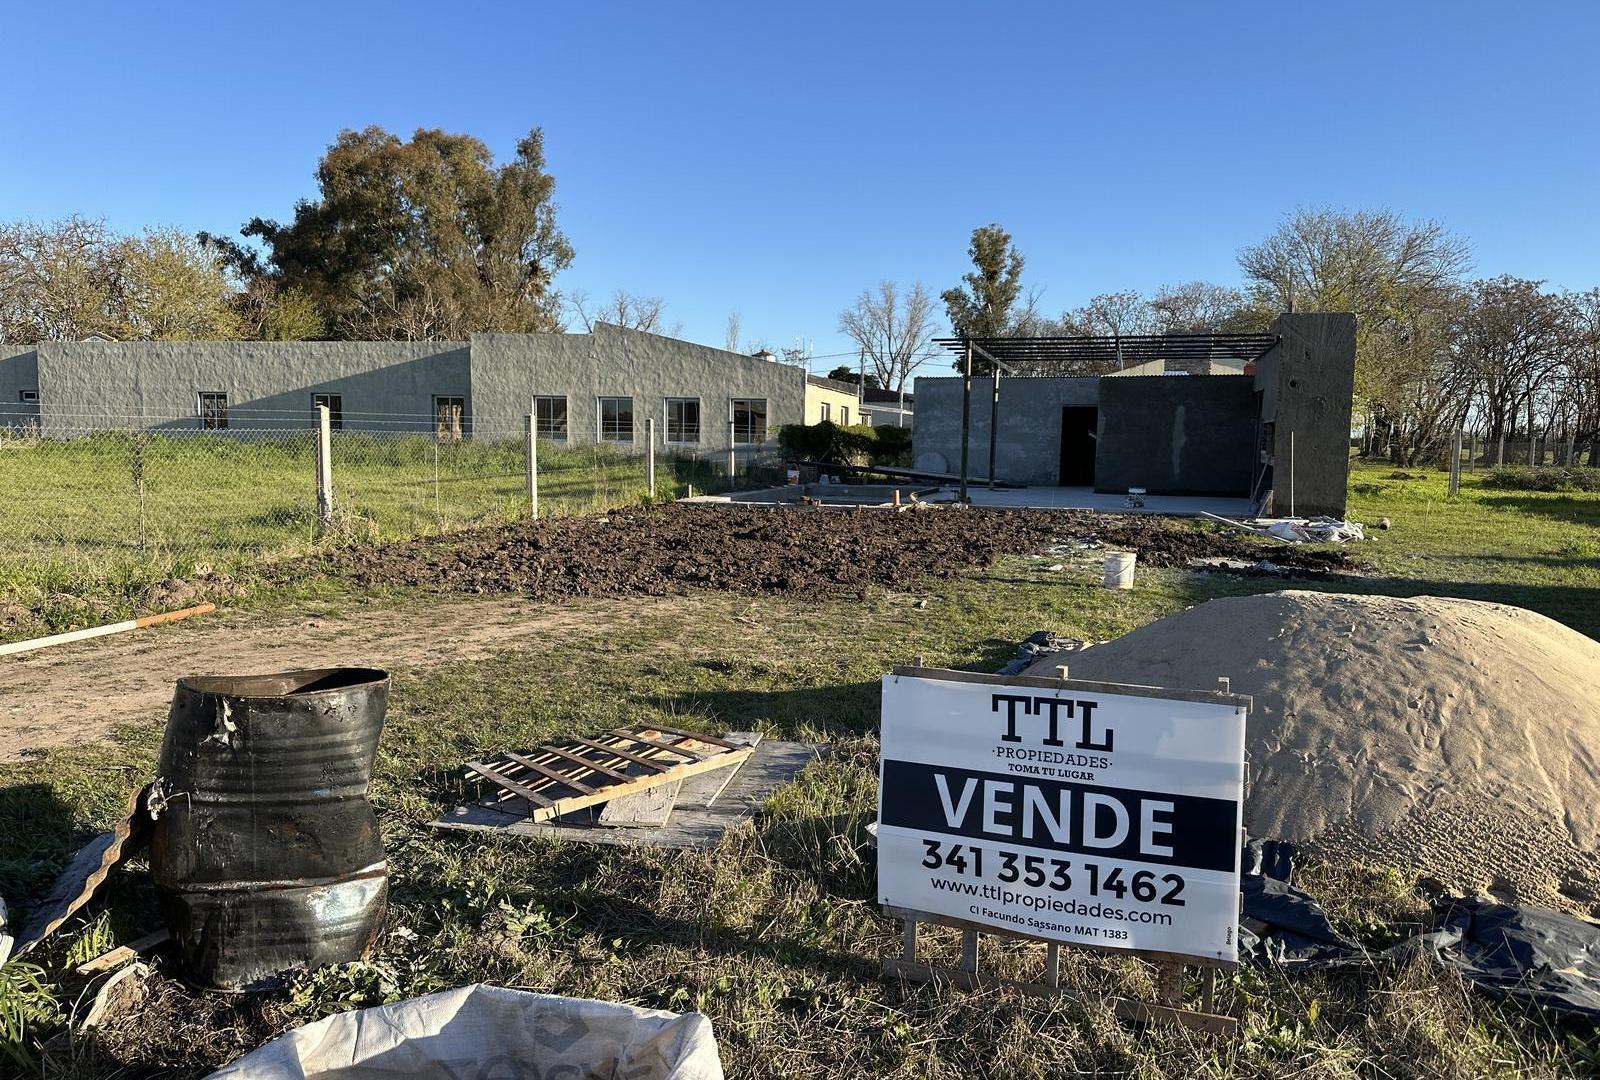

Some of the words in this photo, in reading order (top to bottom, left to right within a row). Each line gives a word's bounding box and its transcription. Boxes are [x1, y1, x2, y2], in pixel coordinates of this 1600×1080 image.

[992, 694, 1113, 752] TTL
[1008, 763, 1040, 775] TOMA
[1042, 767, 1055, 776] TU
[1058, 769, 1095, 781] LUGAR
[934, 773, 1175, 857] VENDE
[921, 839, 983, 877] 341
[997, 850, 1072, 891] 353
[1085, 864, 1186, 907] 1462
[931, 877, 1172, 926] www.ttlpropiedades.com
[982, 908, 1025, 925] Facundo
[1028, 917, 1071, 933] Sassano
[1075, 925, 1099, 938] MAT
[1102, 929, 1128, 940] 1383
